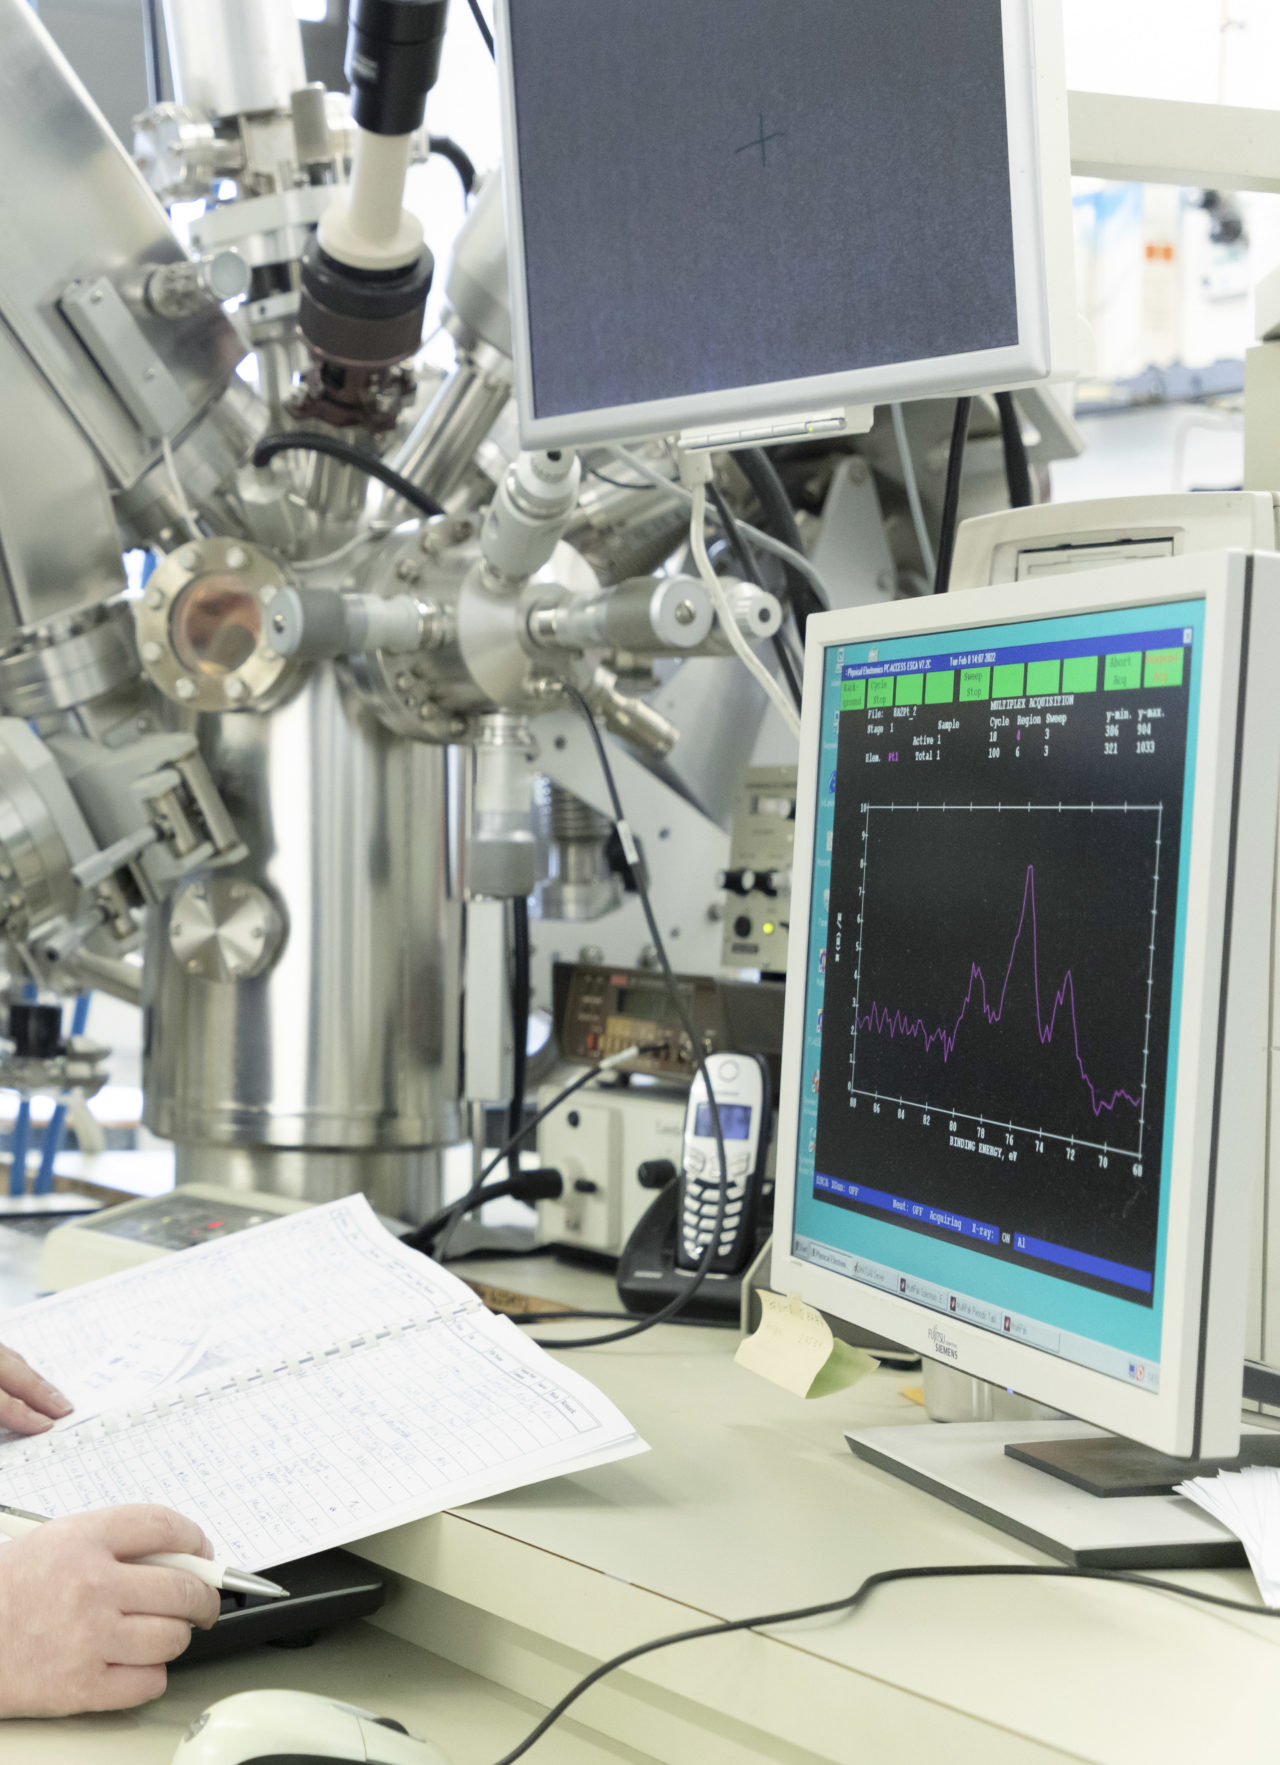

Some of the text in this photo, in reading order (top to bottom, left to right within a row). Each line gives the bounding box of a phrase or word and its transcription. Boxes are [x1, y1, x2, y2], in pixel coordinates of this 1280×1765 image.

[907, 660, 919, 670] ESCA
[964, 671, 983, 683] Sweep
[871, 680, 887, 692] Cycle
[966, 687, 982, 699] Stop
[873, 695, 887, 706] Stop
[990, 694, 1074, 710] MULTIPLEX ACQUISITION
[868, 709, 884, 719] File:
[1106, 707, 1165, 723] y-min. y-max.
[938, 718, 960, 732] Sample
[989, 713, 1067, 729] Cycle Region Sweep
[867, 722, 894, 736] Stage 1
[1044, 728, 1050, 740] 3
[912, 735, 934, 746] Active
[988, 745, 1049, 759] 100 6 3
[1136, 741, 1155, 754] 1033
[865, 752, 881, 763] Elem.
[915, 750, 933, 761] Total
[849, 1097, 1143, 1177] 88 86 84 82 80 78 76 74 72 70 68
[949, 1135, 1018, 1162] BINDING ENERGY, eV
[912, 1205, 924, 1217] OFF
[929, 1210, 962, 1231] Acquiring
[972, 1222, 995, 1239] X-ray:
[1001, 1232, 1011, 1244] ON
[1017, 1237, 1026, 1249] Al
[935, 1343, 958, 1360] SIEMENS
